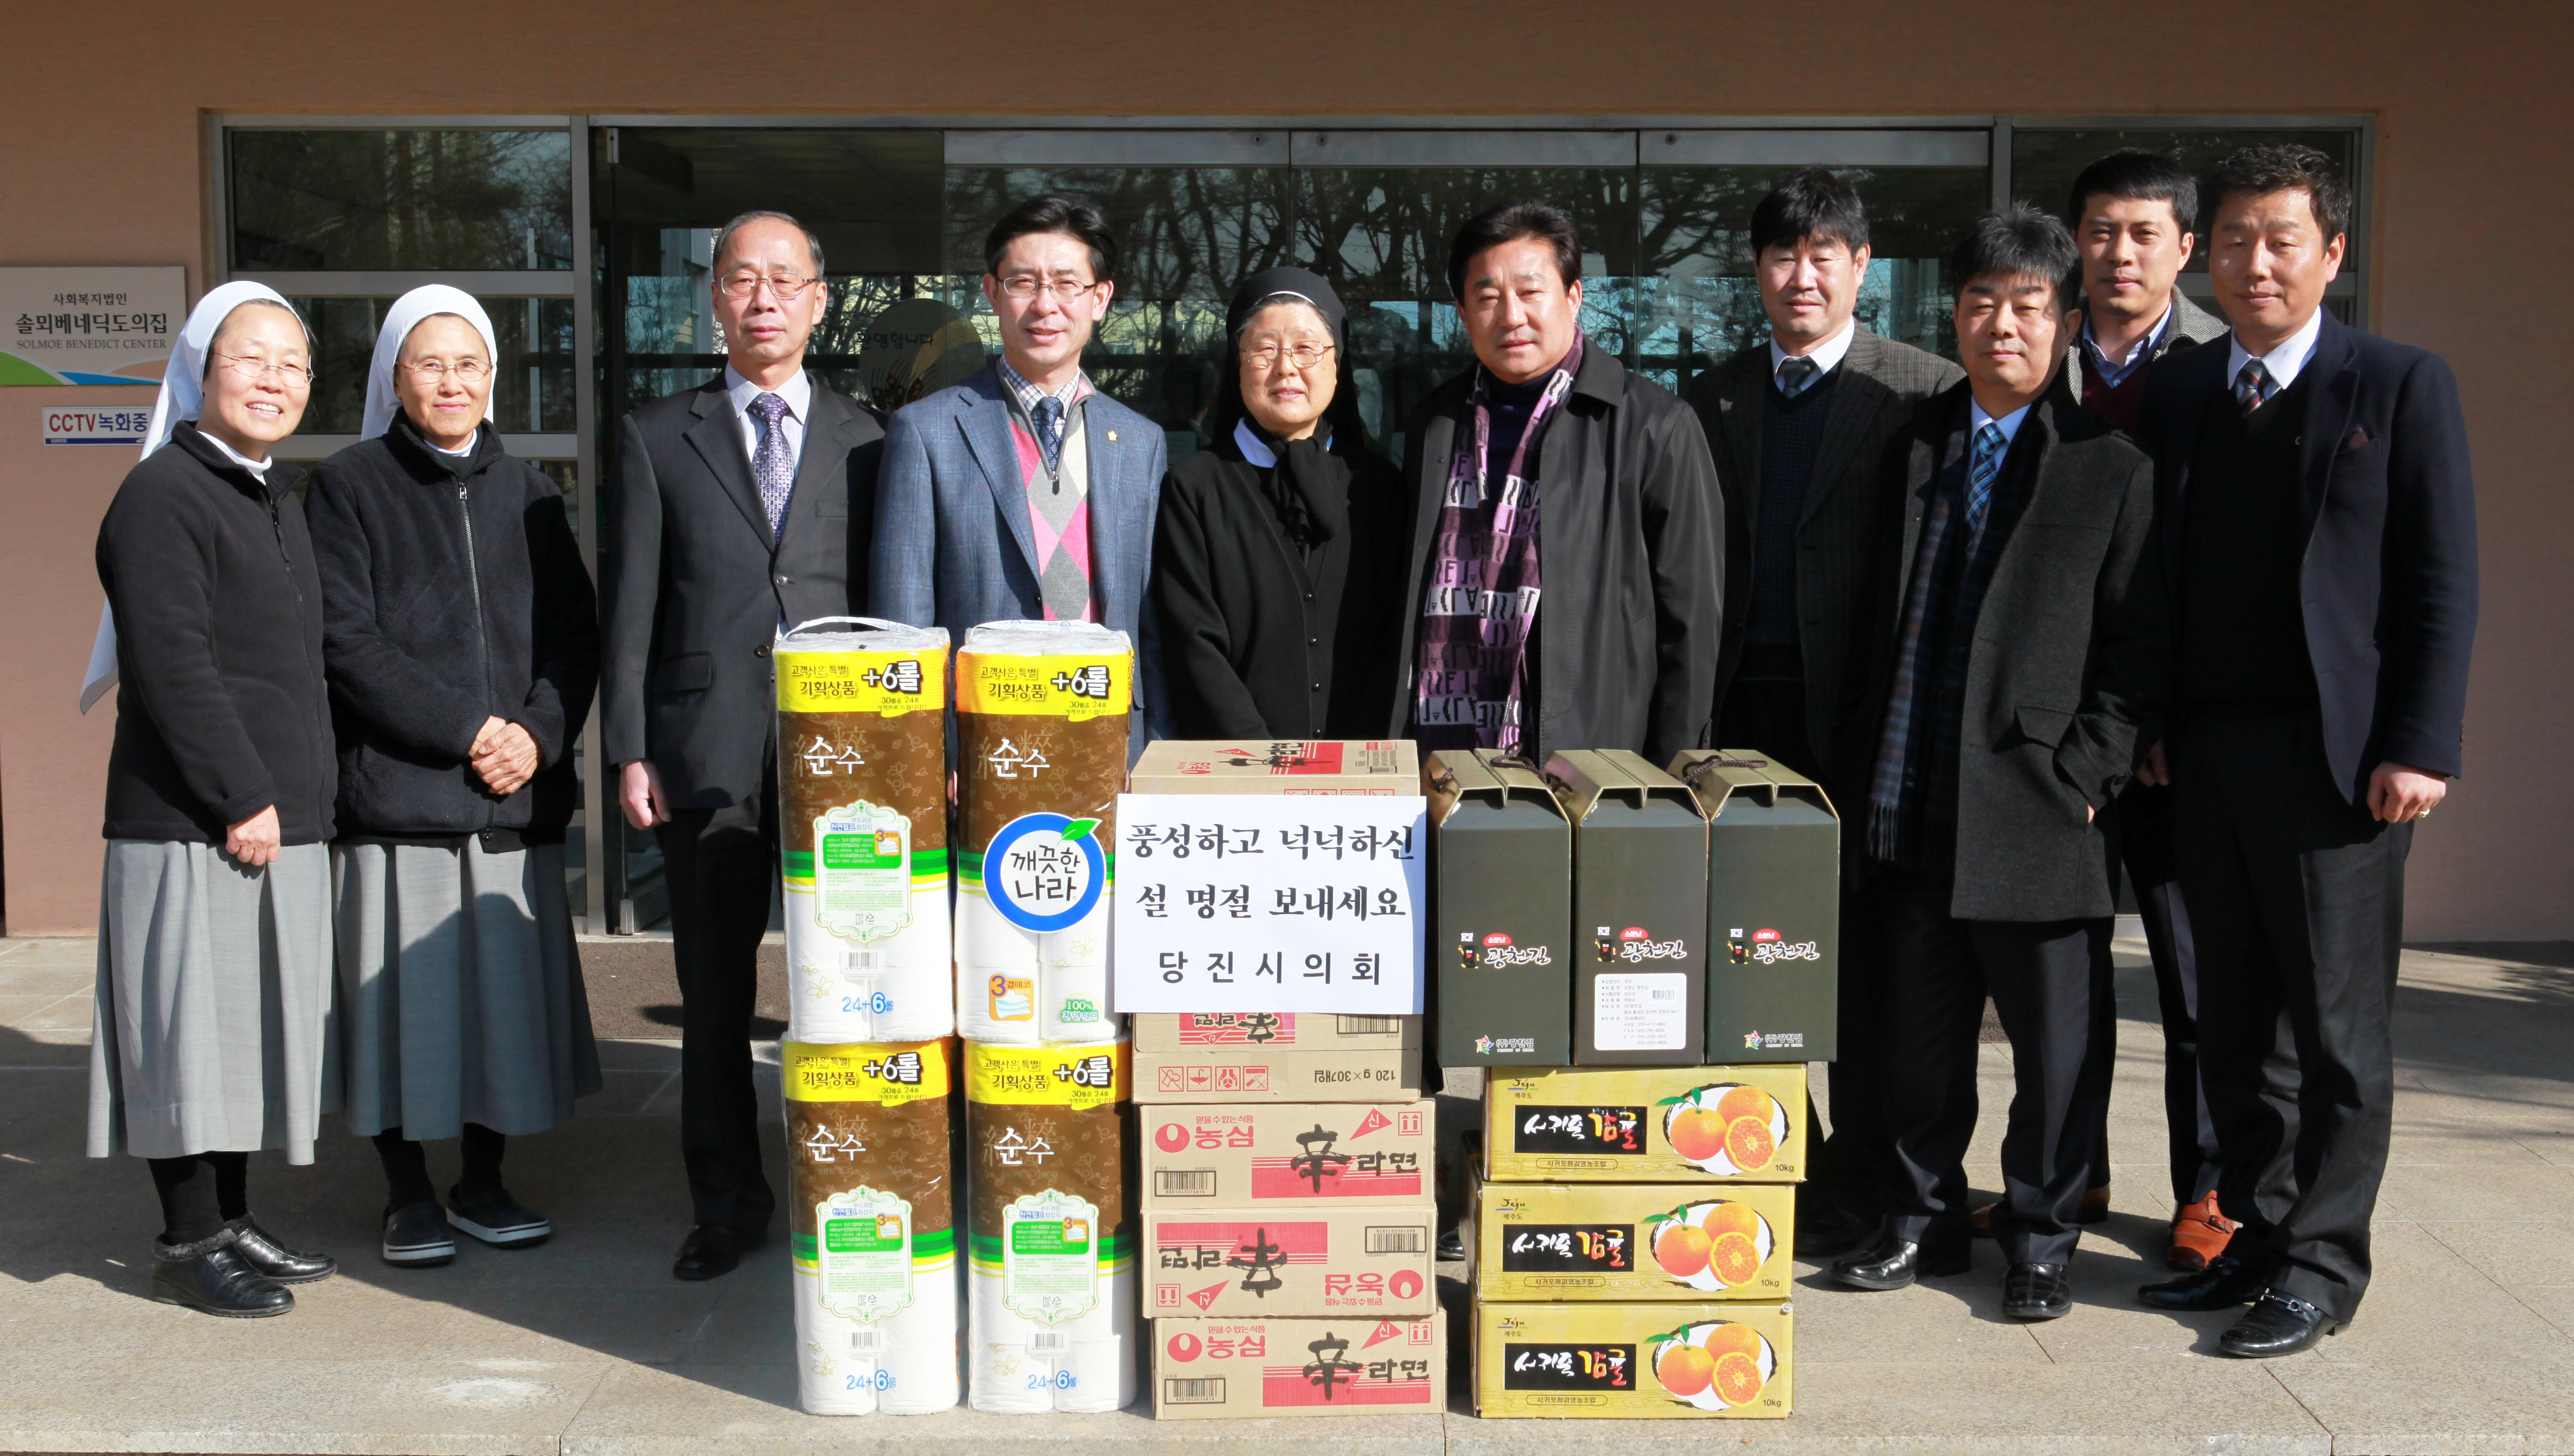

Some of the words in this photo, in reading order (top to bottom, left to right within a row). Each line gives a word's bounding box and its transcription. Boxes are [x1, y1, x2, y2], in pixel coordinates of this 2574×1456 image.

[53, 293, 127, 306] 사회복지법인
[16, 313, 167, 334] 솔뫼베네딕도의집
[17, 339, 62, 349] SOLMOE
[66, 339, 119, 348] BENEDICT
[123, 339, 166, 348] CENTER
[829, 665, 846, 675] 특별
[1019, 668, 1036, 678] 특별
[801, 681, 855, 696] 기획상품
[988, 683, 1044, 698] 기획상품
[804, 736, 865, 774] 순수
[988, 739, 1050, 777] 순수
[1126, 824, 1264, 859] 풍성하고
[1279, 825, 1414, 860] 넉넉하신
[1011, 845, 1081, 874] 깨끗한
[1015, 876, 1077, 901] 나라
[1136, 884, 1168, 918] 설
[1186, 884, 1252, 918] 명절
[1269, 886, 1406, 921] 보내세요
[1485, 946, 1551, 969] 광천김
[1621, 939, 1687, 963] 광천김
[1754, 941, 1820, 964] 광천김
[1067, 1001, 1093, 1010] 100%
[1062, 1011, 1098, 1022] 천연펄프
[831, 1057, 848, 1067] 특별
[1022, 1060, 1038, 1068] 특별
[803, 1072, 856, 1086] 기획상품
[992, 1075, 1047, 1089] 기획상품
[1376, 1070, 1396, 1081] 120
[1512, 1078, 1535, 1090] Jeju
[1368, 1114, 1379, 1128] 신
[1194, 1125, 1254, 1149] 농심
[1588, 1112, 1638, 1149] 감귤
[807, 1125, 867, 1161] 순수
[994, 1128, 1054, 1164] 순수
[1775, 1164, 1795, 1173] 10kg
[1500, 1198, 1525, 1210] Jeju
[1576, 1229, 1625, 1267] 감귤
[1325, 1273, 1384, 1296] 농심
[1760, 1279, 1779, 1287] 10kg
[1199, 1293, 1210, 1305] 신
[1502, 1317, 1524, 1329] Jeju
[1379, 1324, 1390, 1337] 신
[1207, 1335, 1265, 1358] 농심
[1578, 1349, 1626, 1386] 감귤
[1763, 1399, 1782, 1408] 10kg
